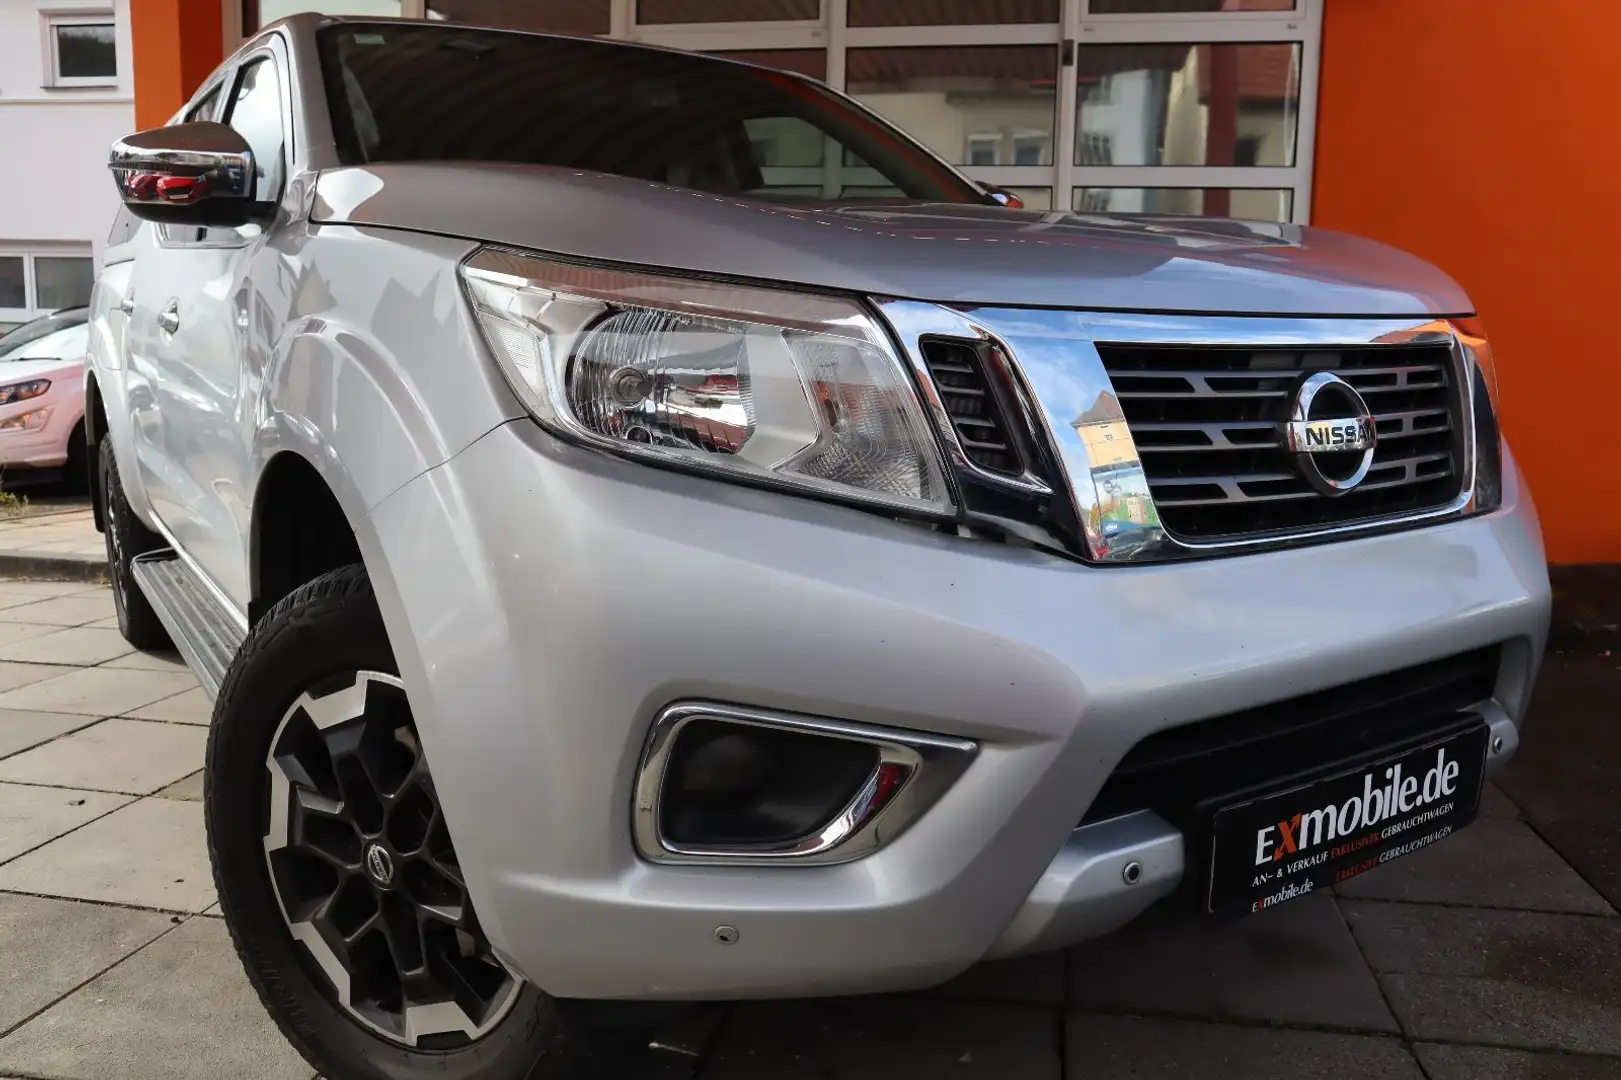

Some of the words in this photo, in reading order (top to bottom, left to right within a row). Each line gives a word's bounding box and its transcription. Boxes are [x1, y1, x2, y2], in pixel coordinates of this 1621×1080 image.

[1276, 868, 1284, 878] &
[1286, 851, 1329, 874] VERKAUF
[1381, 801, 1455, 839] GEBRAUCHTWAGEN
[1379, 825, 1453, 863] GEBRAUCHTWAGEN
